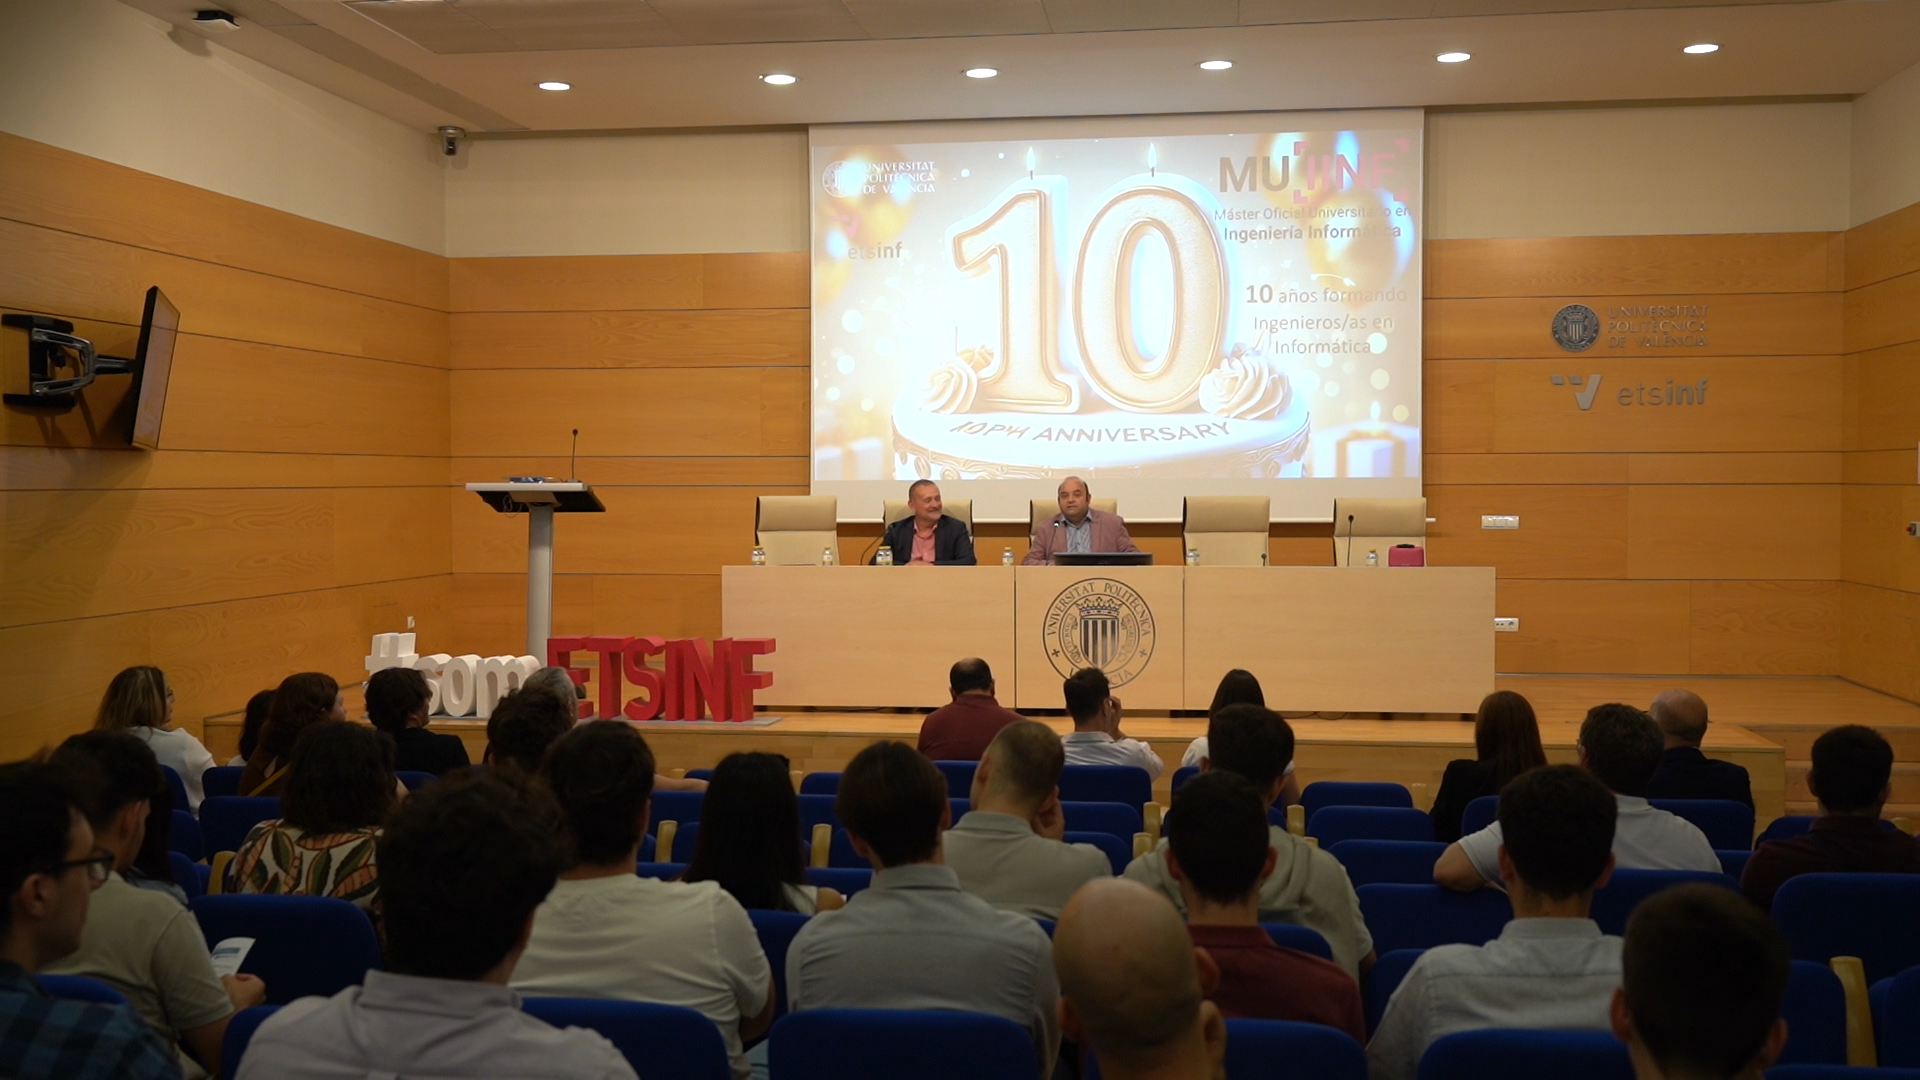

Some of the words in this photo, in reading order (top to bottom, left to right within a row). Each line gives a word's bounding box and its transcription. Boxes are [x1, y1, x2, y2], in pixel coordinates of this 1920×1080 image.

[863, 161, 935, 172] UNIVERSITAT
[863, 184, 877, 195] DE
[882, 183, 936, 194] VANCIA
[1214, 207, 1260, 221] Máster
[1263, 206, 1305, 220] Oficial
[1310, 205, 1392, 219] Universitao
[1395, 207, 1411, 217] en
[1224, 225, 1303, 244] Ingeniería
[1308, 224, 1401, 240] Informáa
[847, 241, 903, 260] etsinf
[951, 185, 1227, 409] 10
[1246, 284, 1273, 304] 10
[1278, 288, 1318, 304] años
[1323, 286, 1408, 304] formando
[1607, 305, 1709, 319] UNIVERSITAT
[1254, 314, 1367, 334] Ingenieros/as
[1372, 316, 1394, 330] en
[1275, 339, 1371, 355] Informática
[1607, 335, 1626, 349] DE
[1616, 377, 1709, 406] etsinf
[1032, 421, 1230, 443] ANNIVERSARY
